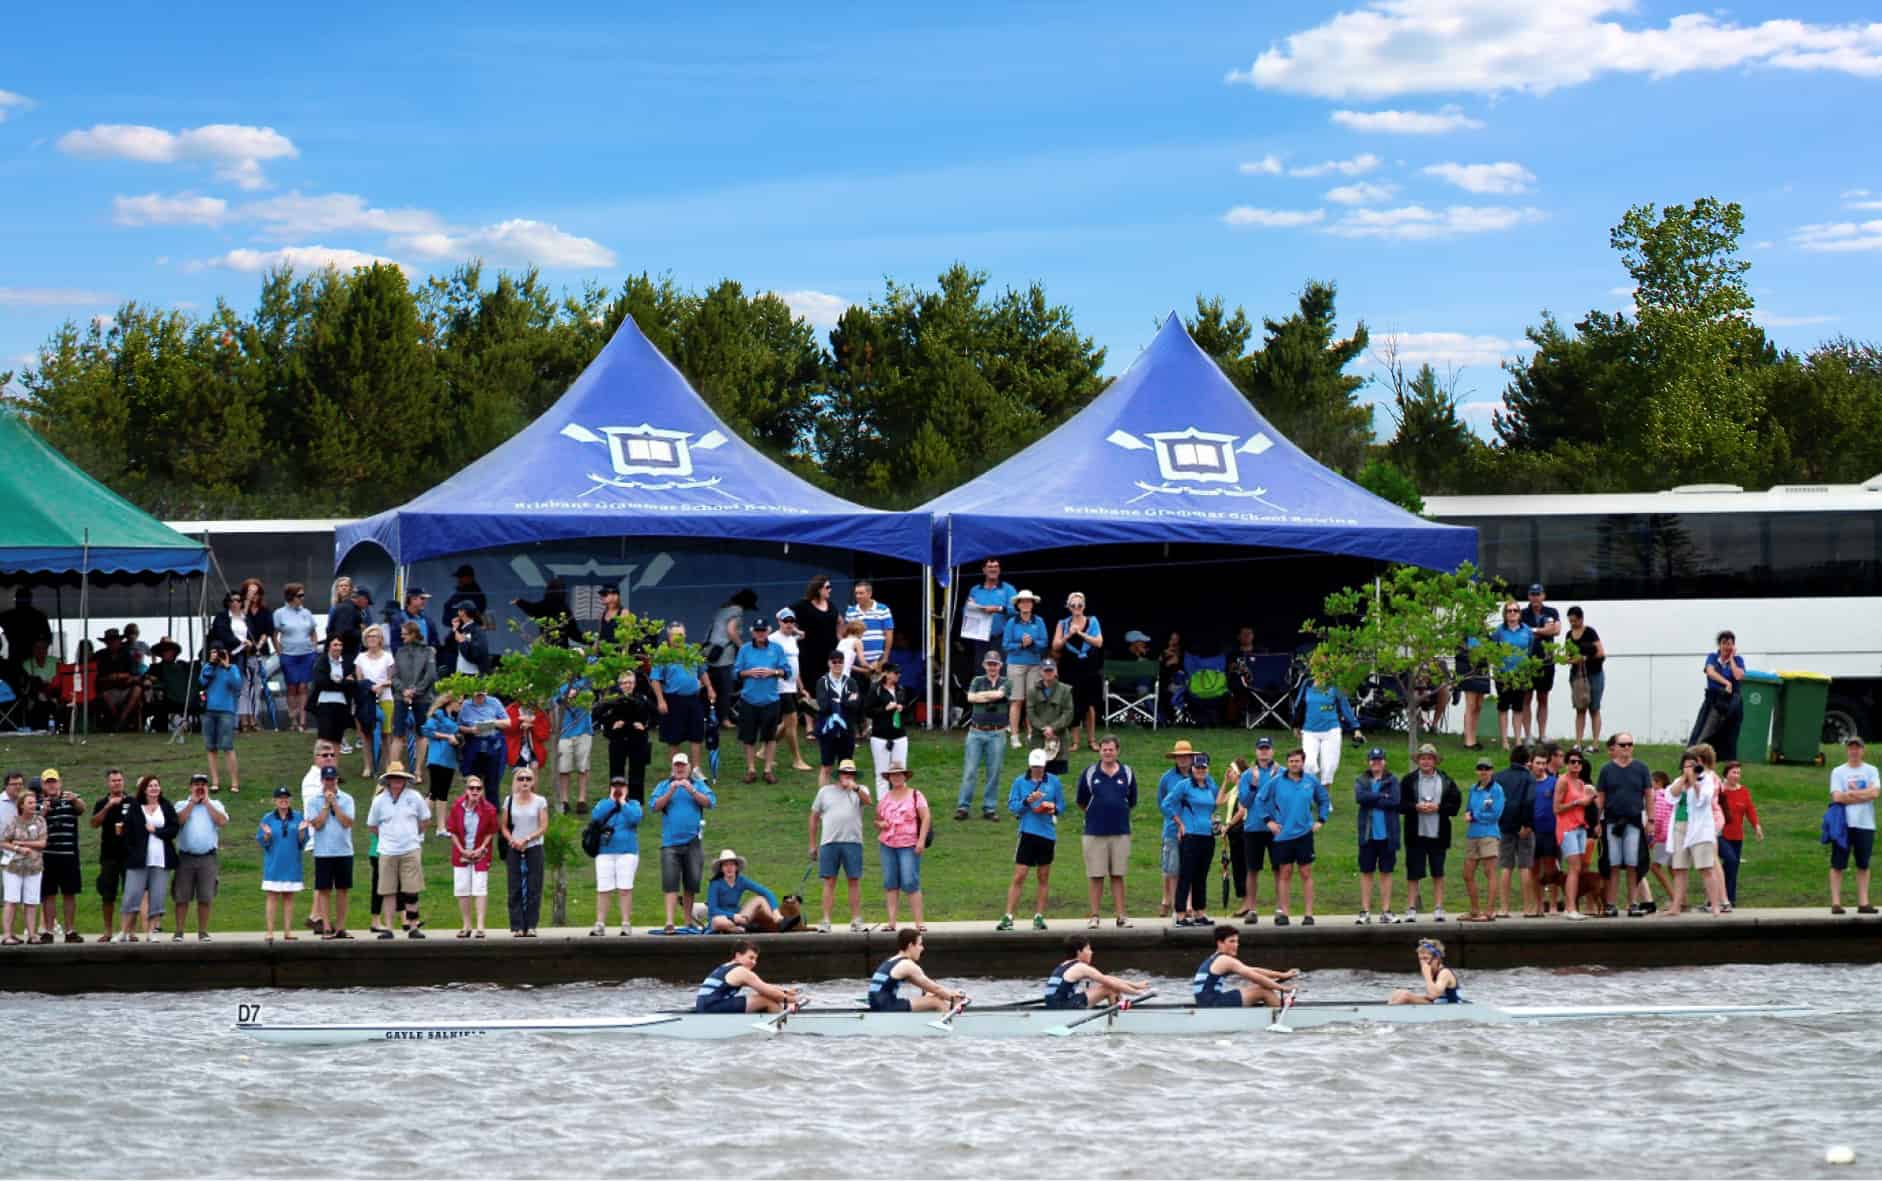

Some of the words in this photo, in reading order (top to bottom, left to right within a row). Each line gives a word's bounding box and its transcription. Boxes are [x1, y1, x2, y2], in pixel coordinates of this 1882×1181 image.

[1064, 505, 1140, 516] Brisbane
[1144, 507, 1225, 519] Grammar
[239, 1004, 261, 1022] D7
[385, 1031, 423, 1040] GAYLE
